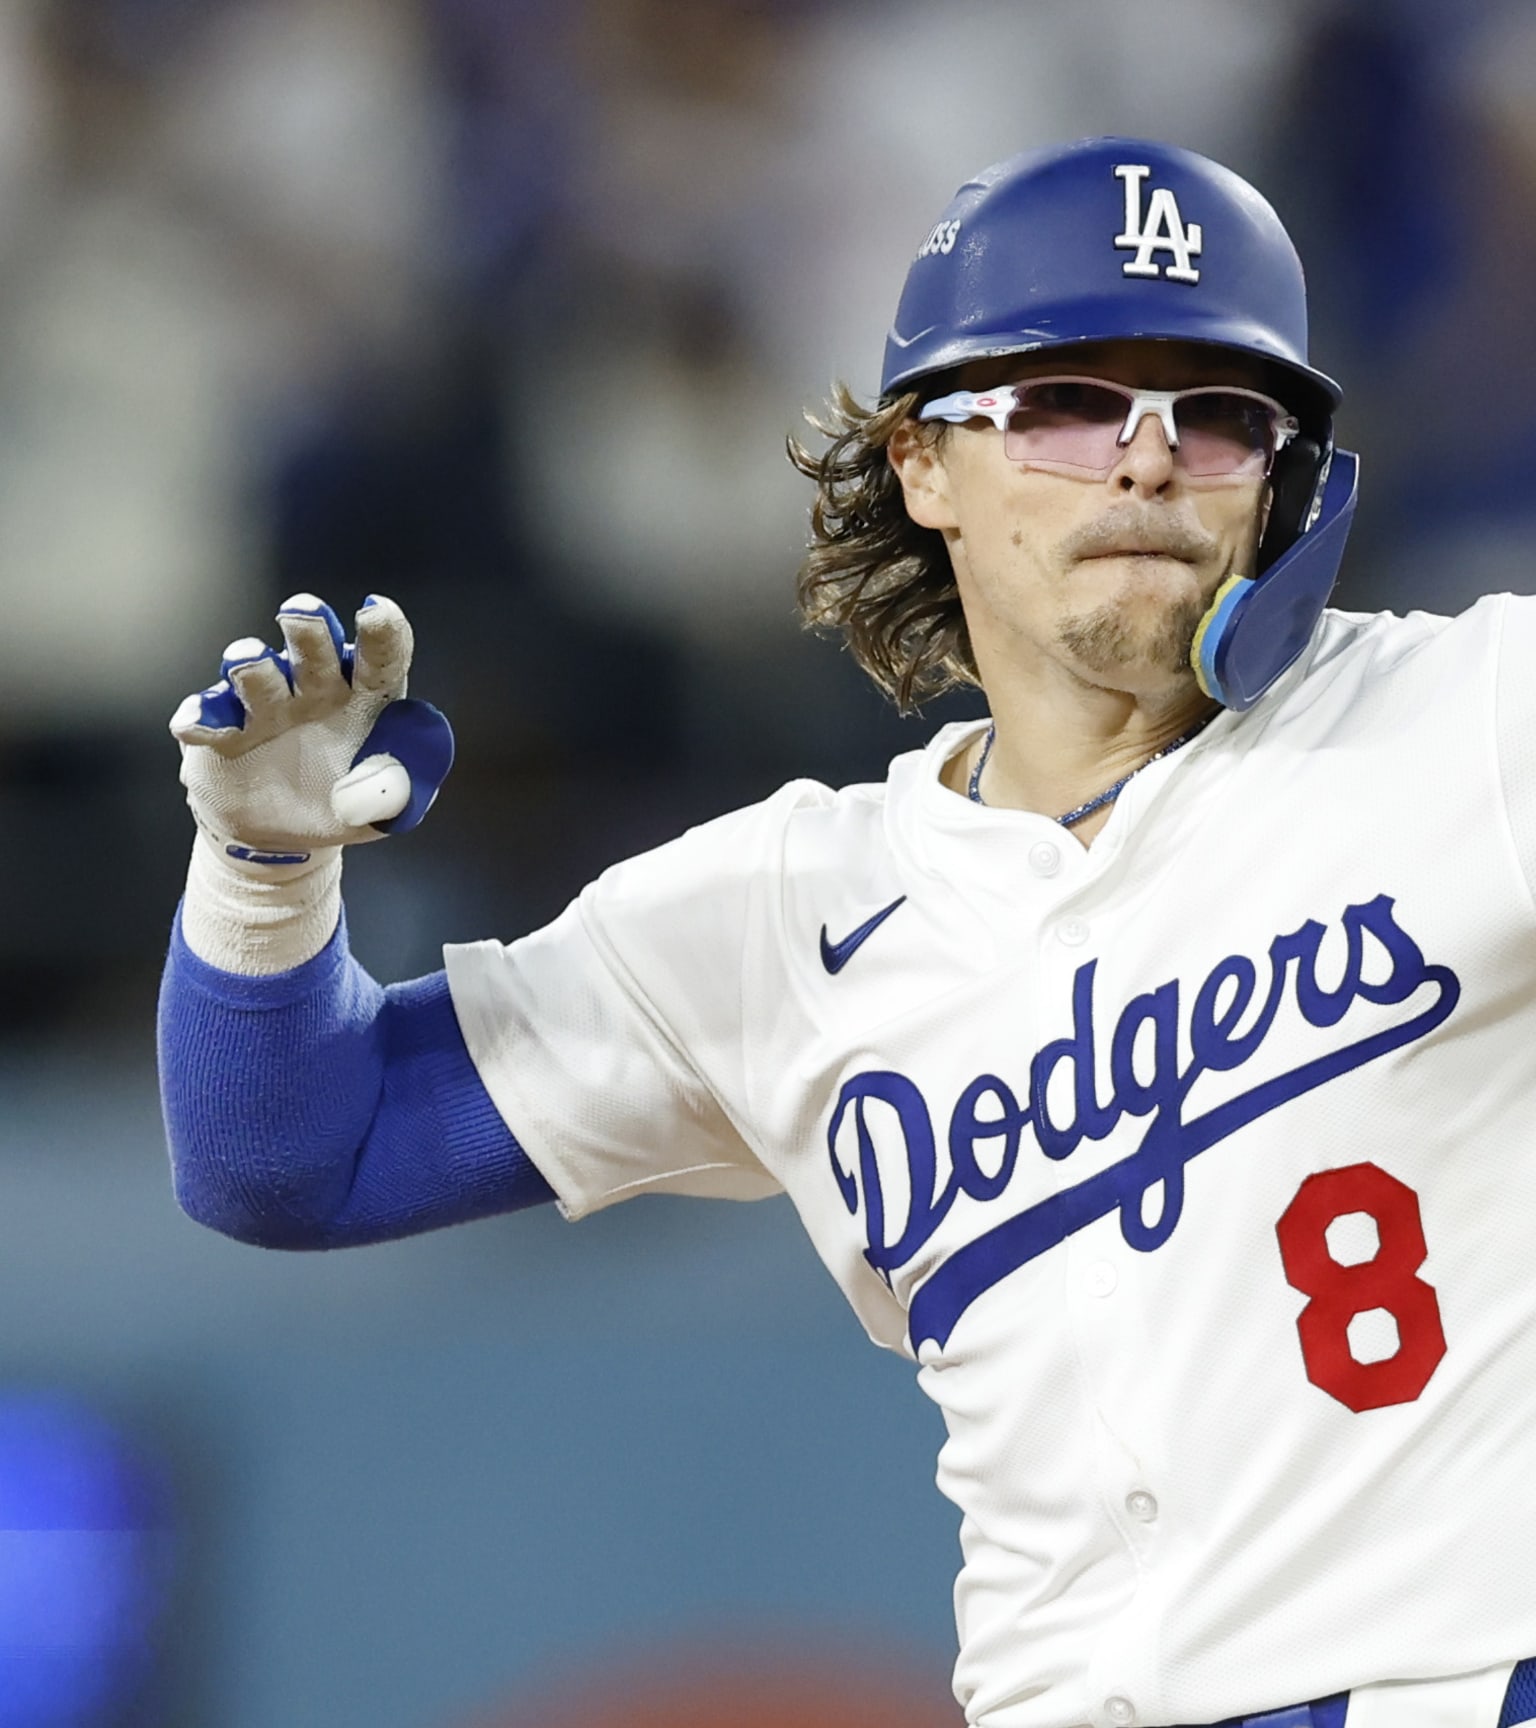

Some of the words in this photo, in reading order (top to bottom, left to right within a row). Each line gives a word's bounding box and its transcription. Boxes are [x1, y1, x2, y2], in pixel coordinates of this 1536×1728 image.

[1114, 164, 1202, 282] LA
[828, 893, 1460, 1354] Dodgers
[1275, 1161, 1447, 1413] 8
